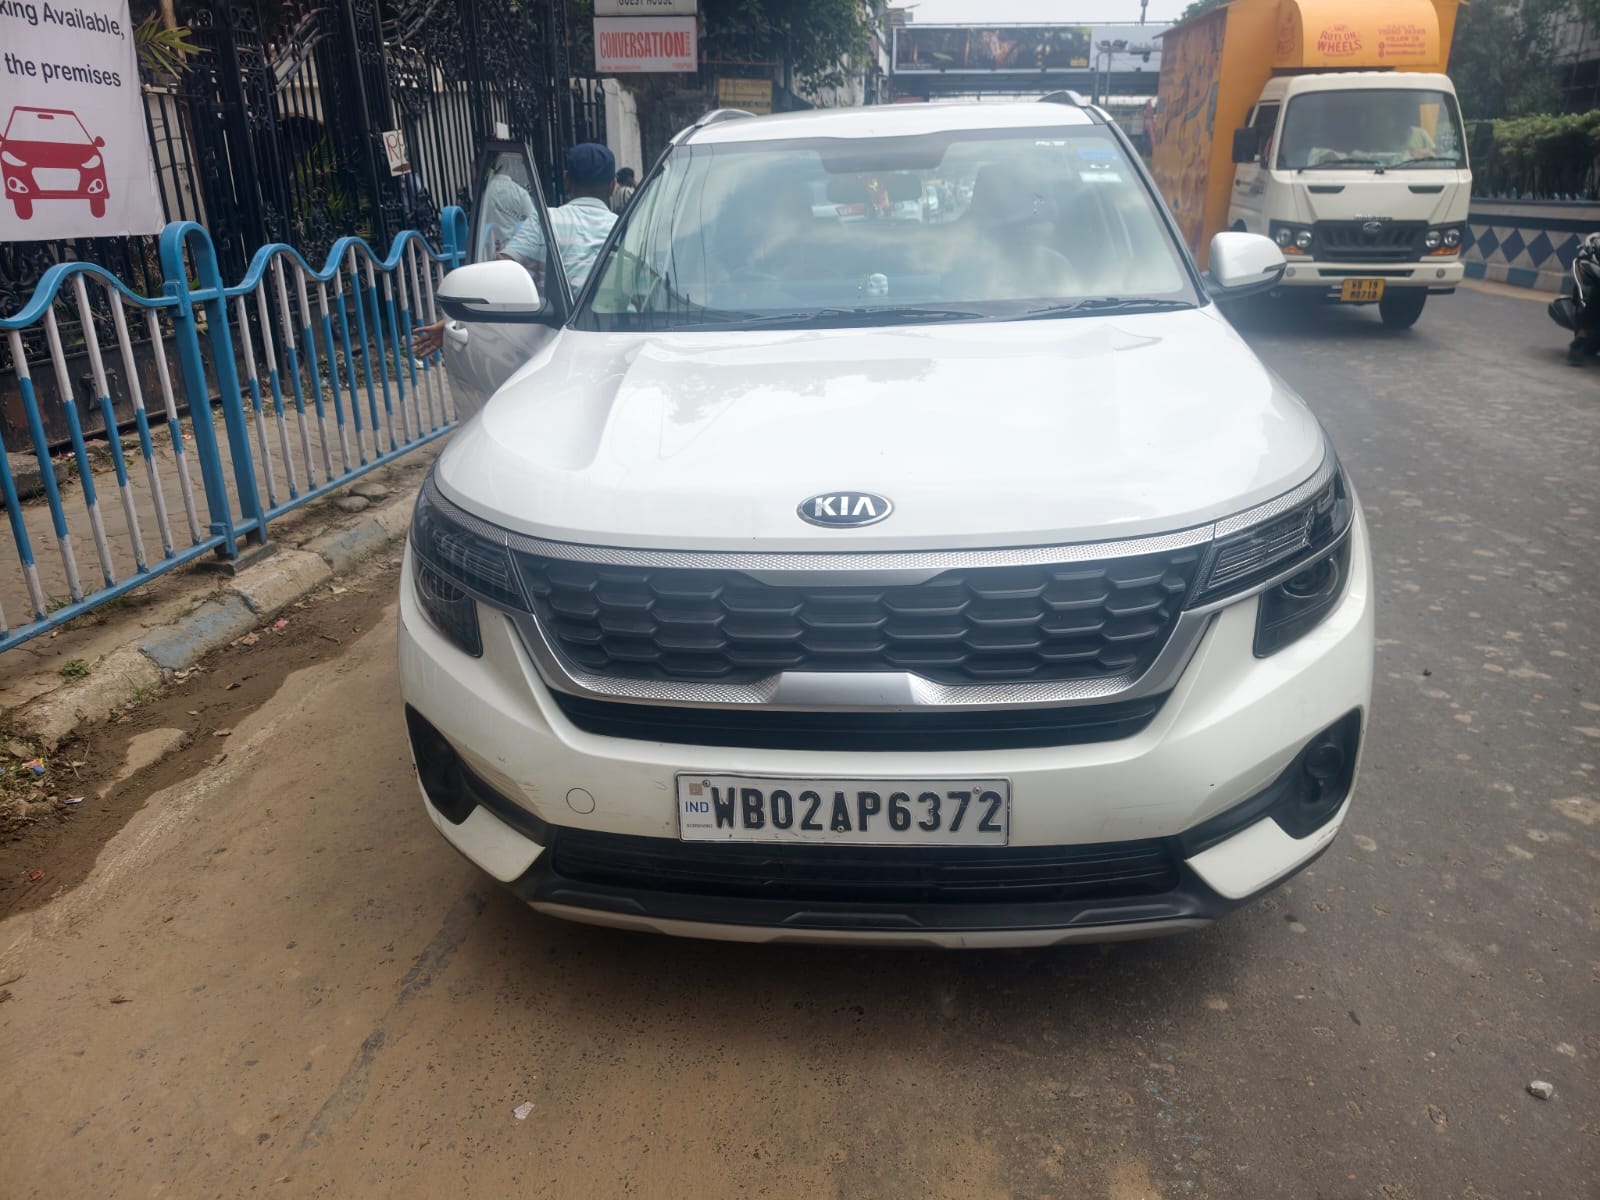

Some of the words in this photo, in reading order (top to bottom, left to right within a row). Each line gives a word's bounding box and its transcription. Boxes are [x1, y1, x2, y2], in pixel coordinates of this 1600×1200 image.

[43, 2, 125, 40] Available,
[600, 31, 685, 58] CONVERSATION
[1317, 39, 1362, 53] WHEELS
[4, 52, 37, 77] the
[41, 62, 121, 87] premises
[814, 496, 876, 517] KIA
[685, 800, 709, 813] IND
[711, 786, 1002, 832] WB02AP6372
